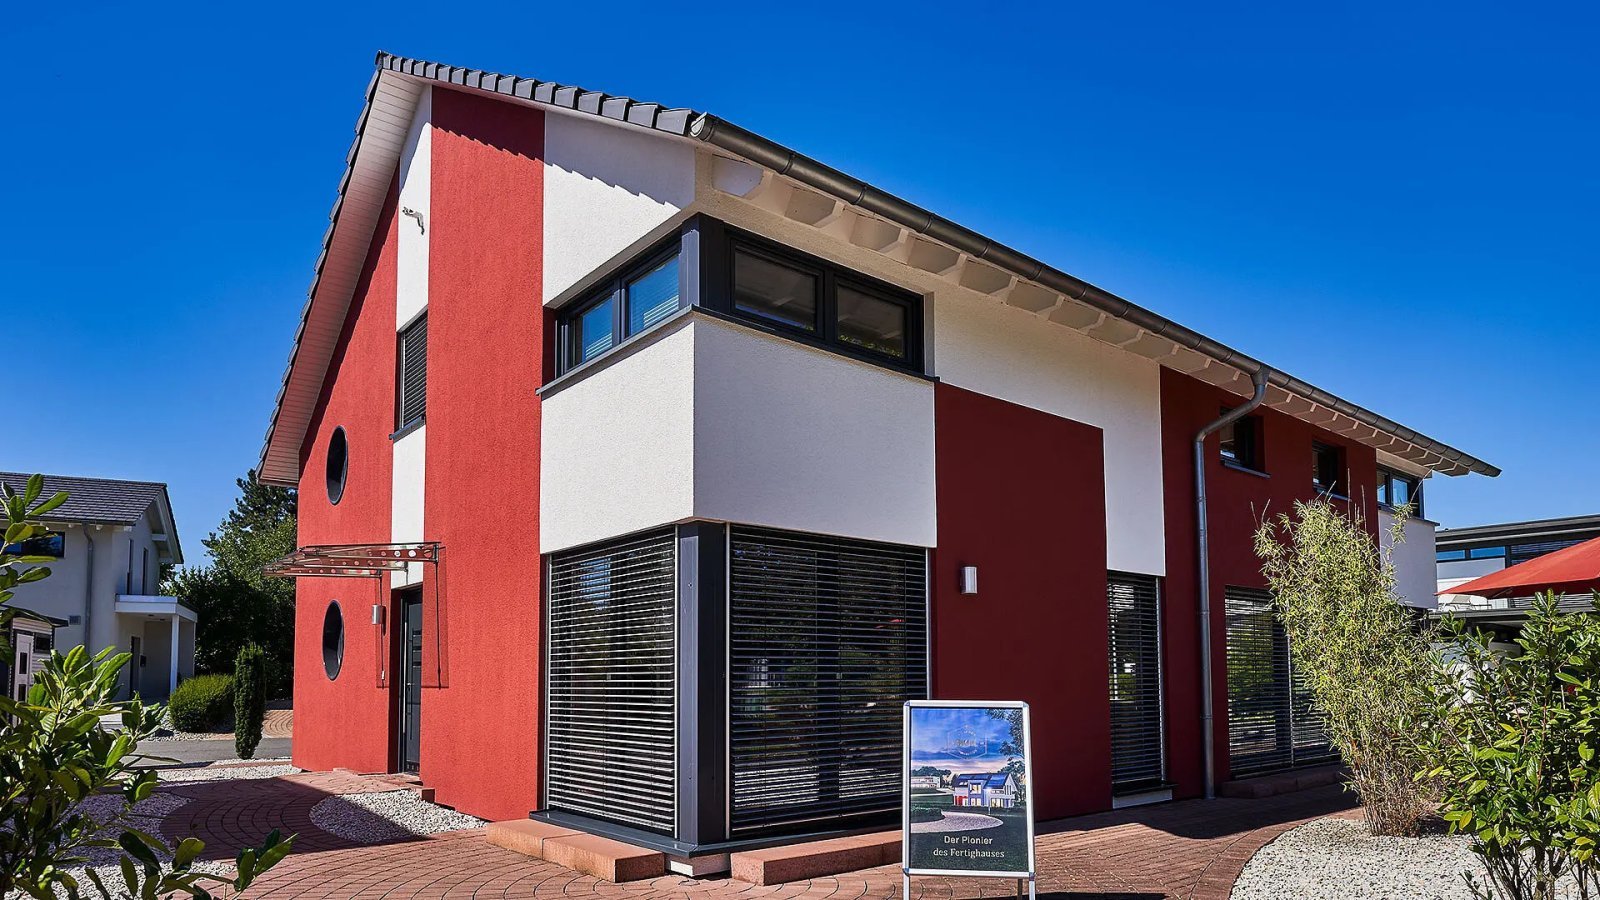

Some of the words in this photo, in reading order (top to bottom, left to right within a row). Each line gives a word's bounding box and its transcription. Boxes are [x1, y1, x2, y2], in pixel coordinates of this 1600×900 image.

[944, 836, 959, 844] Der
[961, 836, 993, 845] Pionier
[933, 848, 948, 857] des
[950, 848, 1005, 859] Fertighauses
